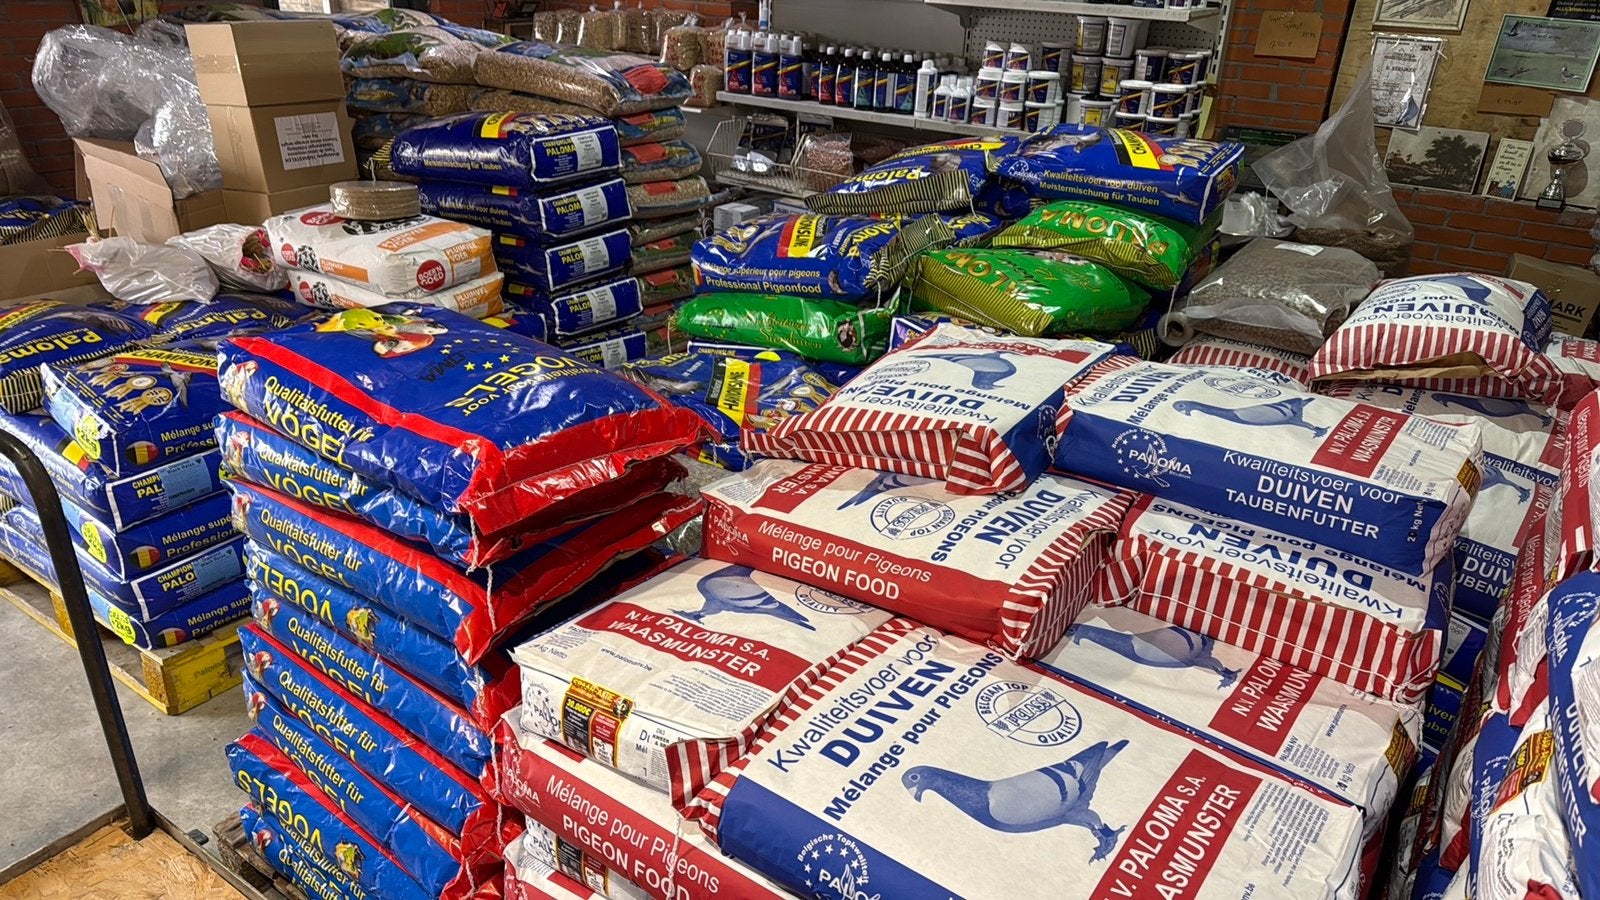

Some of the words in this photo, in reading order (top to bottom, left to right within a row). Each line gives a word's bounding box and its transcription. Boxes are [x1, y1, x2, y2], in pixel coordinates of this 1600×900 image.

[1039, 181, 1110, 200] Meistermischung
[1111, 190, 1123, 201] für
[1124, 191, 1161, 207] Tauben
[1043, 170, 1102, 188] Kwaliteitsvoer
[1103, 177, 1126, 188] voor
[1127, 180, 1159, 194] duiven
[451, 253, 469, 263] VOER
[767, 268, 787, 280] pour
[788, 268, 821, 281] pigeons
[705, 276, 762, 292] Professional
[763, 280, 823, 294] Pigeonfood
[461, 393, 501, 416] voor
[911, 380, 952, 393] pour
[954, 387, 1031, 411] Mélange
[855, 393, 998, 424] Kwaliteitsvoer
[1126, 390, 1169, 426] Mélange
[1340, 411, 1366, 444] PALOMA
[159, 422, 202, 443] Mélange
[258, 443, 348, 489] Qualitätsfutter
[1128, 449, 1193, 475] PALOMA
[1223, 450, 1352, 494] Kwaliteitsvoer
[1358, 485, 1404, 506] voor
[1225, 488, 1380, 540] TAUBENFUTTER
[1257, 474, 1354, 515] DUIVEN
[162, 524, 206, 546] Mélange
[713, 515, 750, 545] PALOMA
[909, 526, 934, 538] TOP
[930, 510, 988, 562] PIGEONS
[974, 489, 1067, 546] DUIVEN
[1148, 525, 1208, 551] voor
[1151, 502, 1256, 540] PIGEONS
[260, 508, 343, 559] Qualitätsfutter
[342, 547, 363, 572] für
[758, 520, 822, 551] Mélange
[823, 541, 863, 564] pour
[863, 552, 932, 583] Pigeons
[995, 537, 1029, 571] voor
[1187, 521, 1375, 592] DUIVEN
[1260, 531, 1318, 555] pour
[772, 546, 841, 583] PIGEON
[844, 569, 900, 601] FOOD
[1214, 542, 1405, 620] Kwaliteitsvoer
[1323, 548, 1428, 594] Mélange
[187, 604, 229, 628] Mélange
[624, 609, 652, 623] N.V.
[655, 617, 738, 647] PALOMA
[740, 641, 771, 662] S.A.
[288, 616, 371, 681] Qualitätsfutter
[369, 671, 389, 694] für
[608, 620, 762, 678] WAASMUNSTER
[279, 670, 358, 738] Qualitätsfutter
[359, 730, 378, 753] für
[767, 661, 902, 774] Kwaliteitsvoer
[896, 634, 942, 673] voor
[818, 659, 957, 768] DUIVEN
[981, 683, 1005, 716] BELGIAN
[1005, 682, 1030, 692] TOP
[1231, 694, 1255, 718] N.V.
[822, 743, 907, 822] Mélange
[901, 707, 943, 747] pour
[941, 652, 1004, 710] PIGEONS
[1036, 715, 1079, 745] QUALITY
[272, 714, 344, 788] Qualitätsfutter
[345, 782, 364, 805] für
[237, 769, 323, 853] VOGELS
[1119, 795, 1190, 880] PALOMA
[1185, 774, 1208, 798] S.A.
[546, 774, 610, 827] Mélange
[610, 817, 649, 850] pour
[650, 836, 721, 895] Pigeons
[562, 814, 630, 871] PIGEON
[634, 858, 692, 900] FOOD
[796, 833, 835, 863] Belgische
[836, 833, 870, 885] Topkwaliteit
